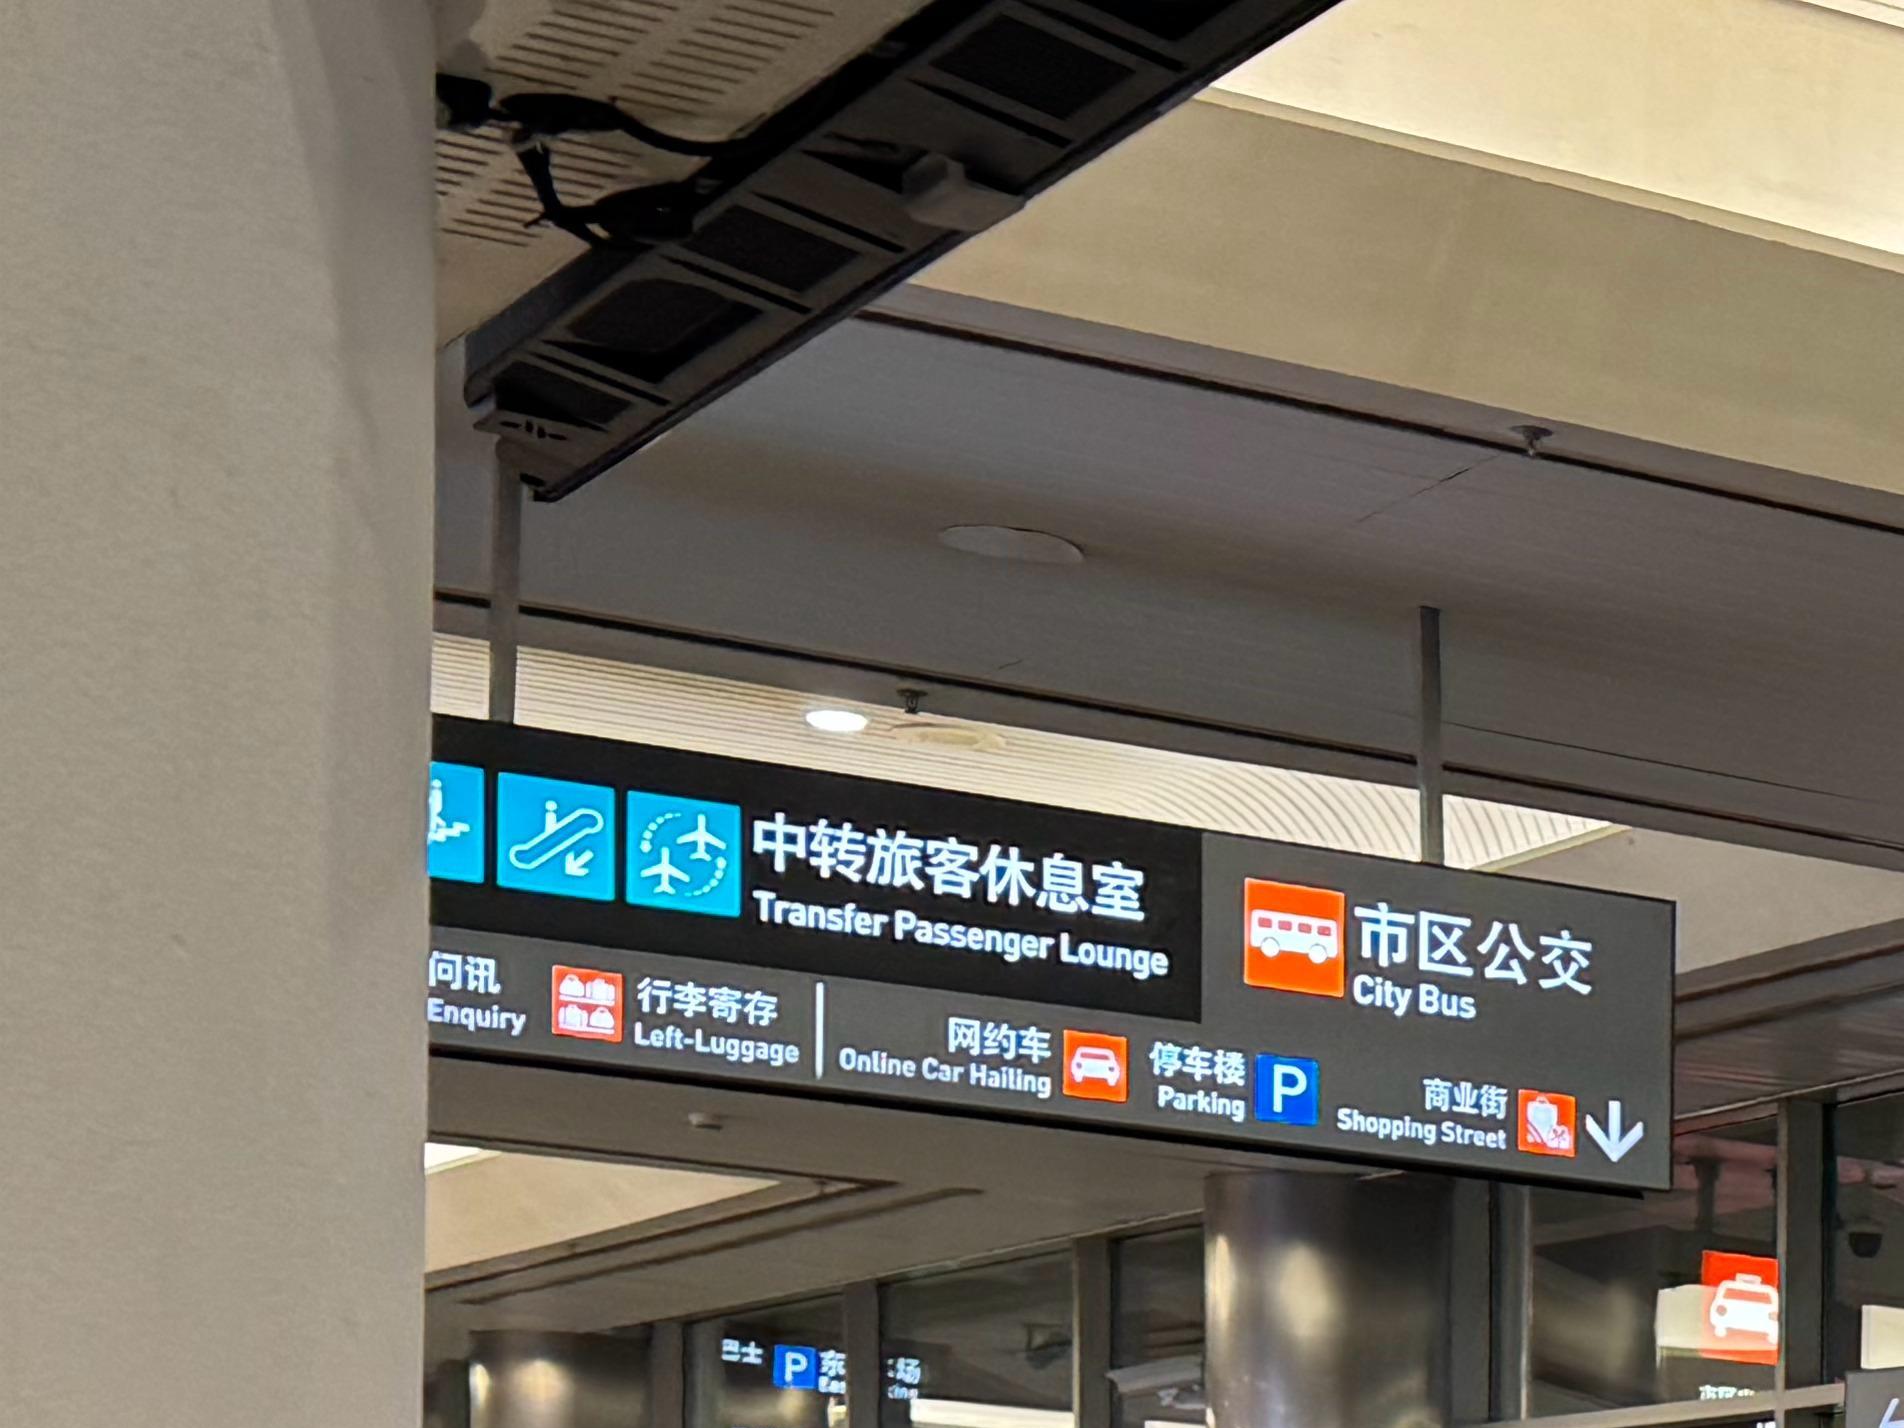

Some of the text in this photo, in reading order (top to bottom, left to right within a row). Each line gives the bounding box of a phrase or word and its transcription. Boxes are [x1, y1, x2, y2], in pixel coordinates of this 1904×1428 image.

[752, 811, 1147, 923] 中转旅客休息室
[752, 890, 1169, 980] Transfer Passenger Lounge
[1353, 901, 1593, 996] 市区公交
[428, 950, 501, 994] 问讯
[427, 999, 526, 1036] Enquiry
[636, 976, 779, 1027] 行李寄存
[1352, 972, 1476, 1020] City Bus
[634, 1022, 800, 1067] Left-Luggage
[947, 1017, 1052, 1064] 网约车
[1149, 1040, 1246, 1087] 停车楼
[838, 1046, 1053, 1101] Online Car Hailing
[1272, 1064, 1308, 1113] P
[1157, 1086, 1246, 1123] Parking
[1422, 1076, 1508, 1121] 商业街
[1336, 1107, 1507, 1151] Shopping Street
[785, 1351, 808, 1383] P
